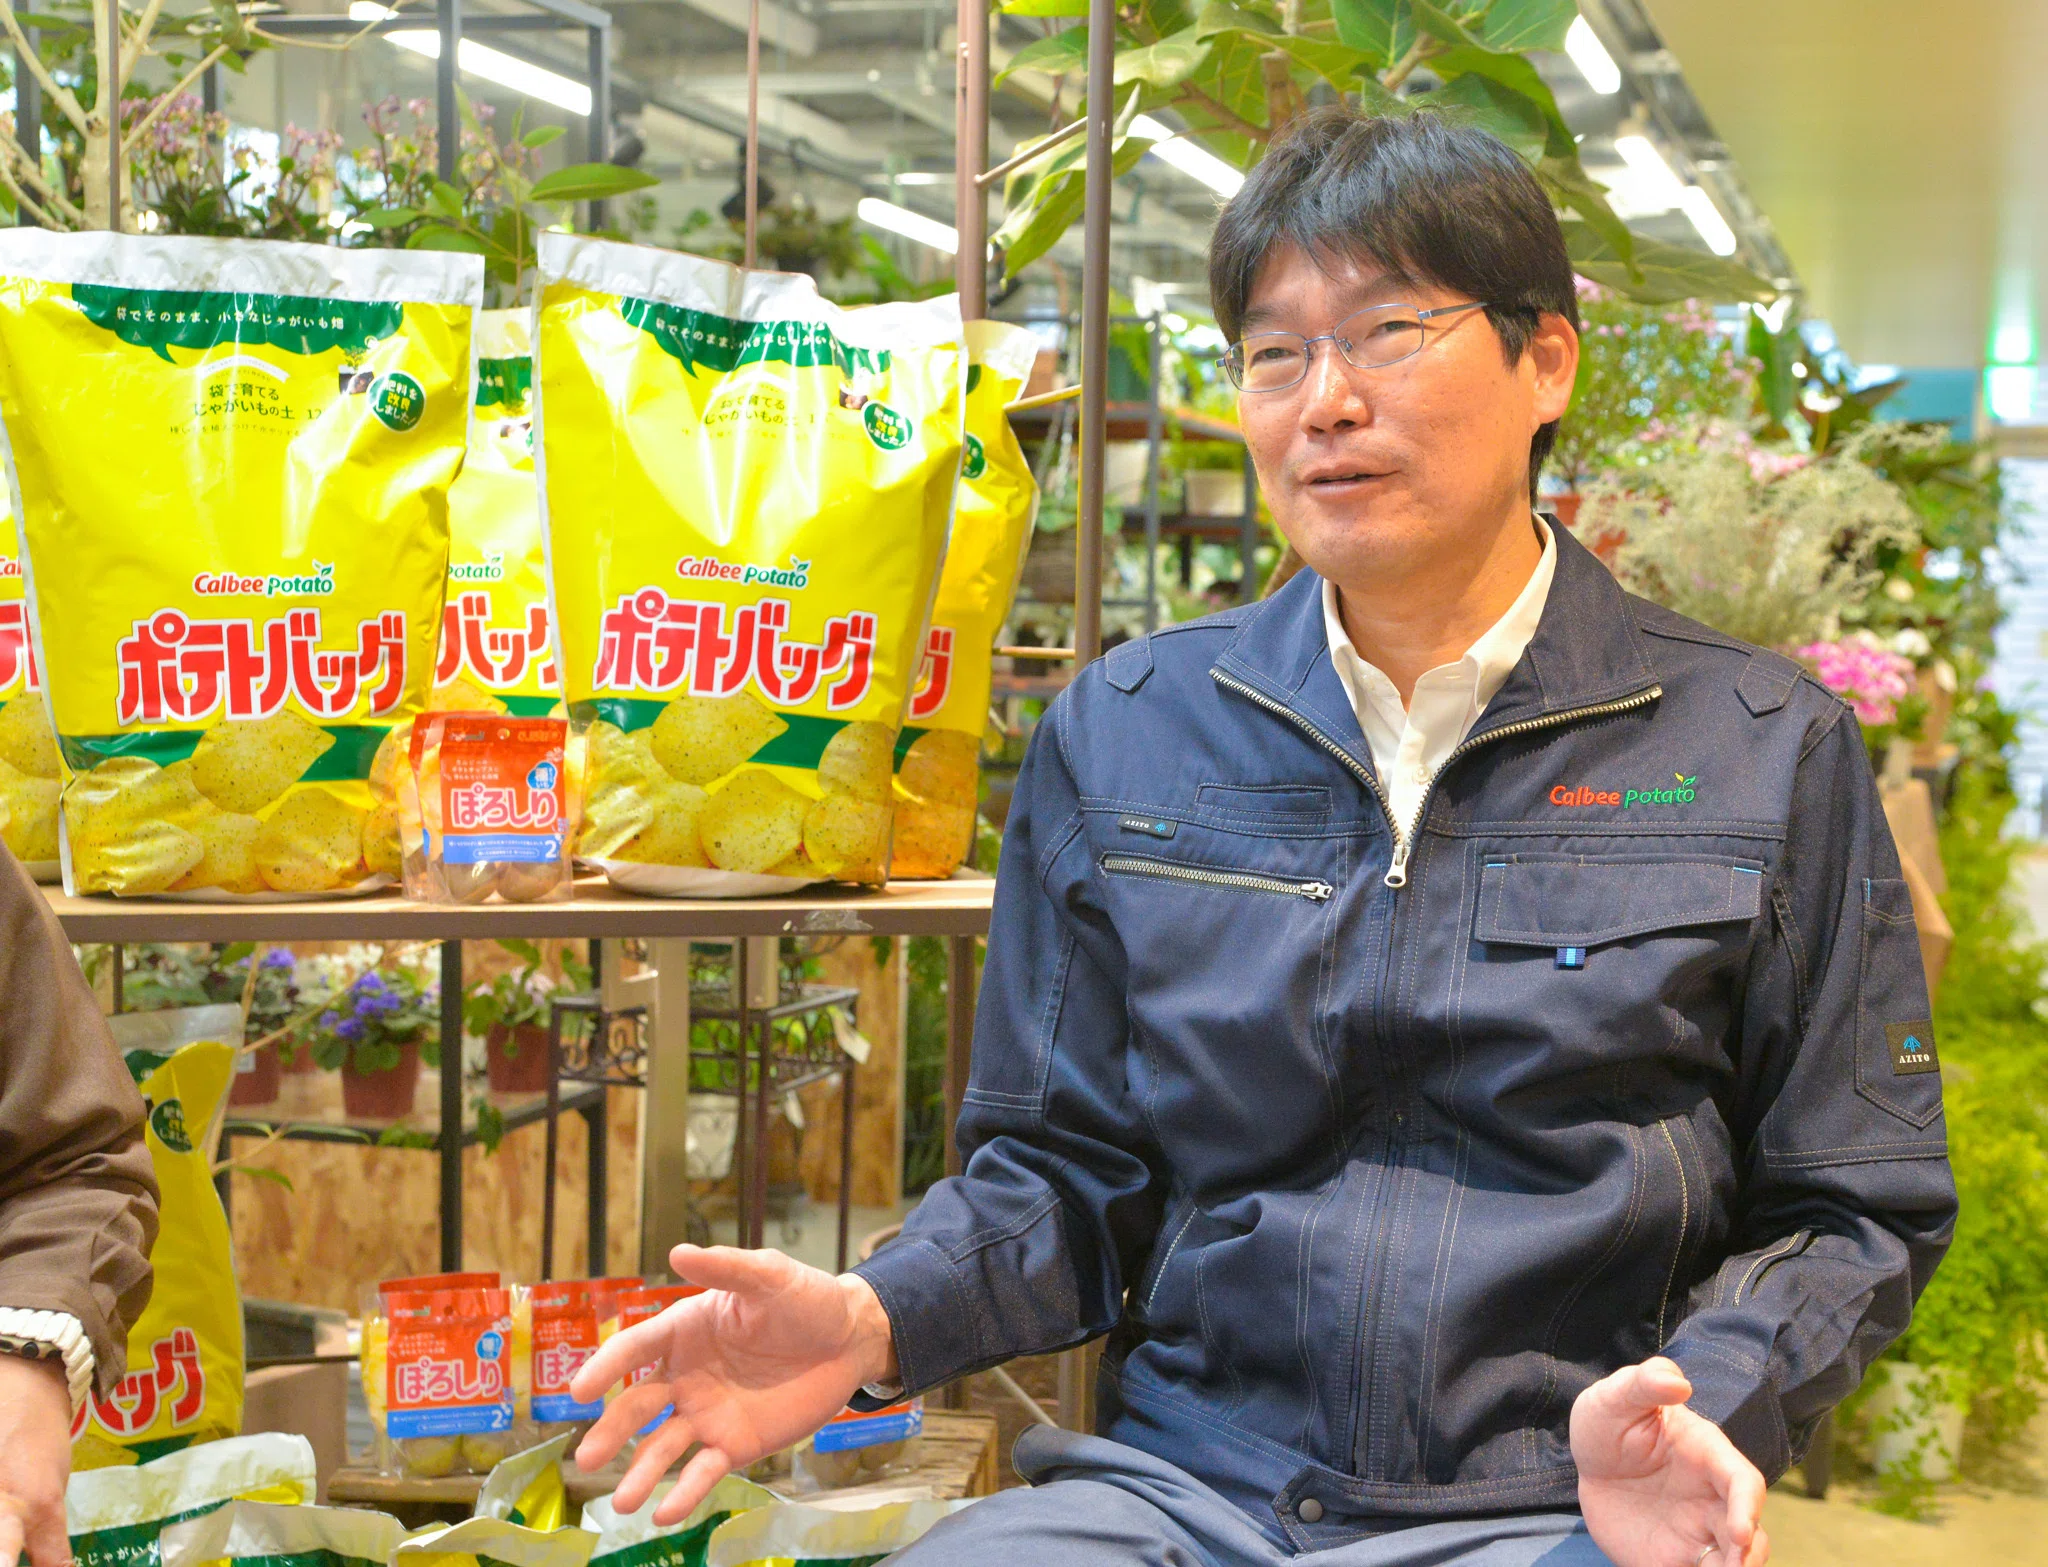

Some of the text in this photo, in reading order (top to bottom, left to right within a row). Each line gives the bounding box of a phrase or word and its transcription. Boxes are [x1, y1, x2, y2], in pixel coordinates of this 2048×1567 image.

[209, 382, 280, 401] 袋で育てる
[194, 399, 296, 420] じゃがいもの土
[678, 557, 742, 579] Calbee
[194, 574, 263, 594] Calbee
[593, 586, 877, 710] ポテトバッグ
[118, 609, 406, 725] ポテトバッグ
[451, 782, 558, 829] ぽろしり
[1550, 785, 1621, 807] Calbee
[1125, 820, 1150, 829] AZITO
[1899, 1053, 1930, 1064] AZITO
[395, 1355, 503, 1404] ぽろしり
